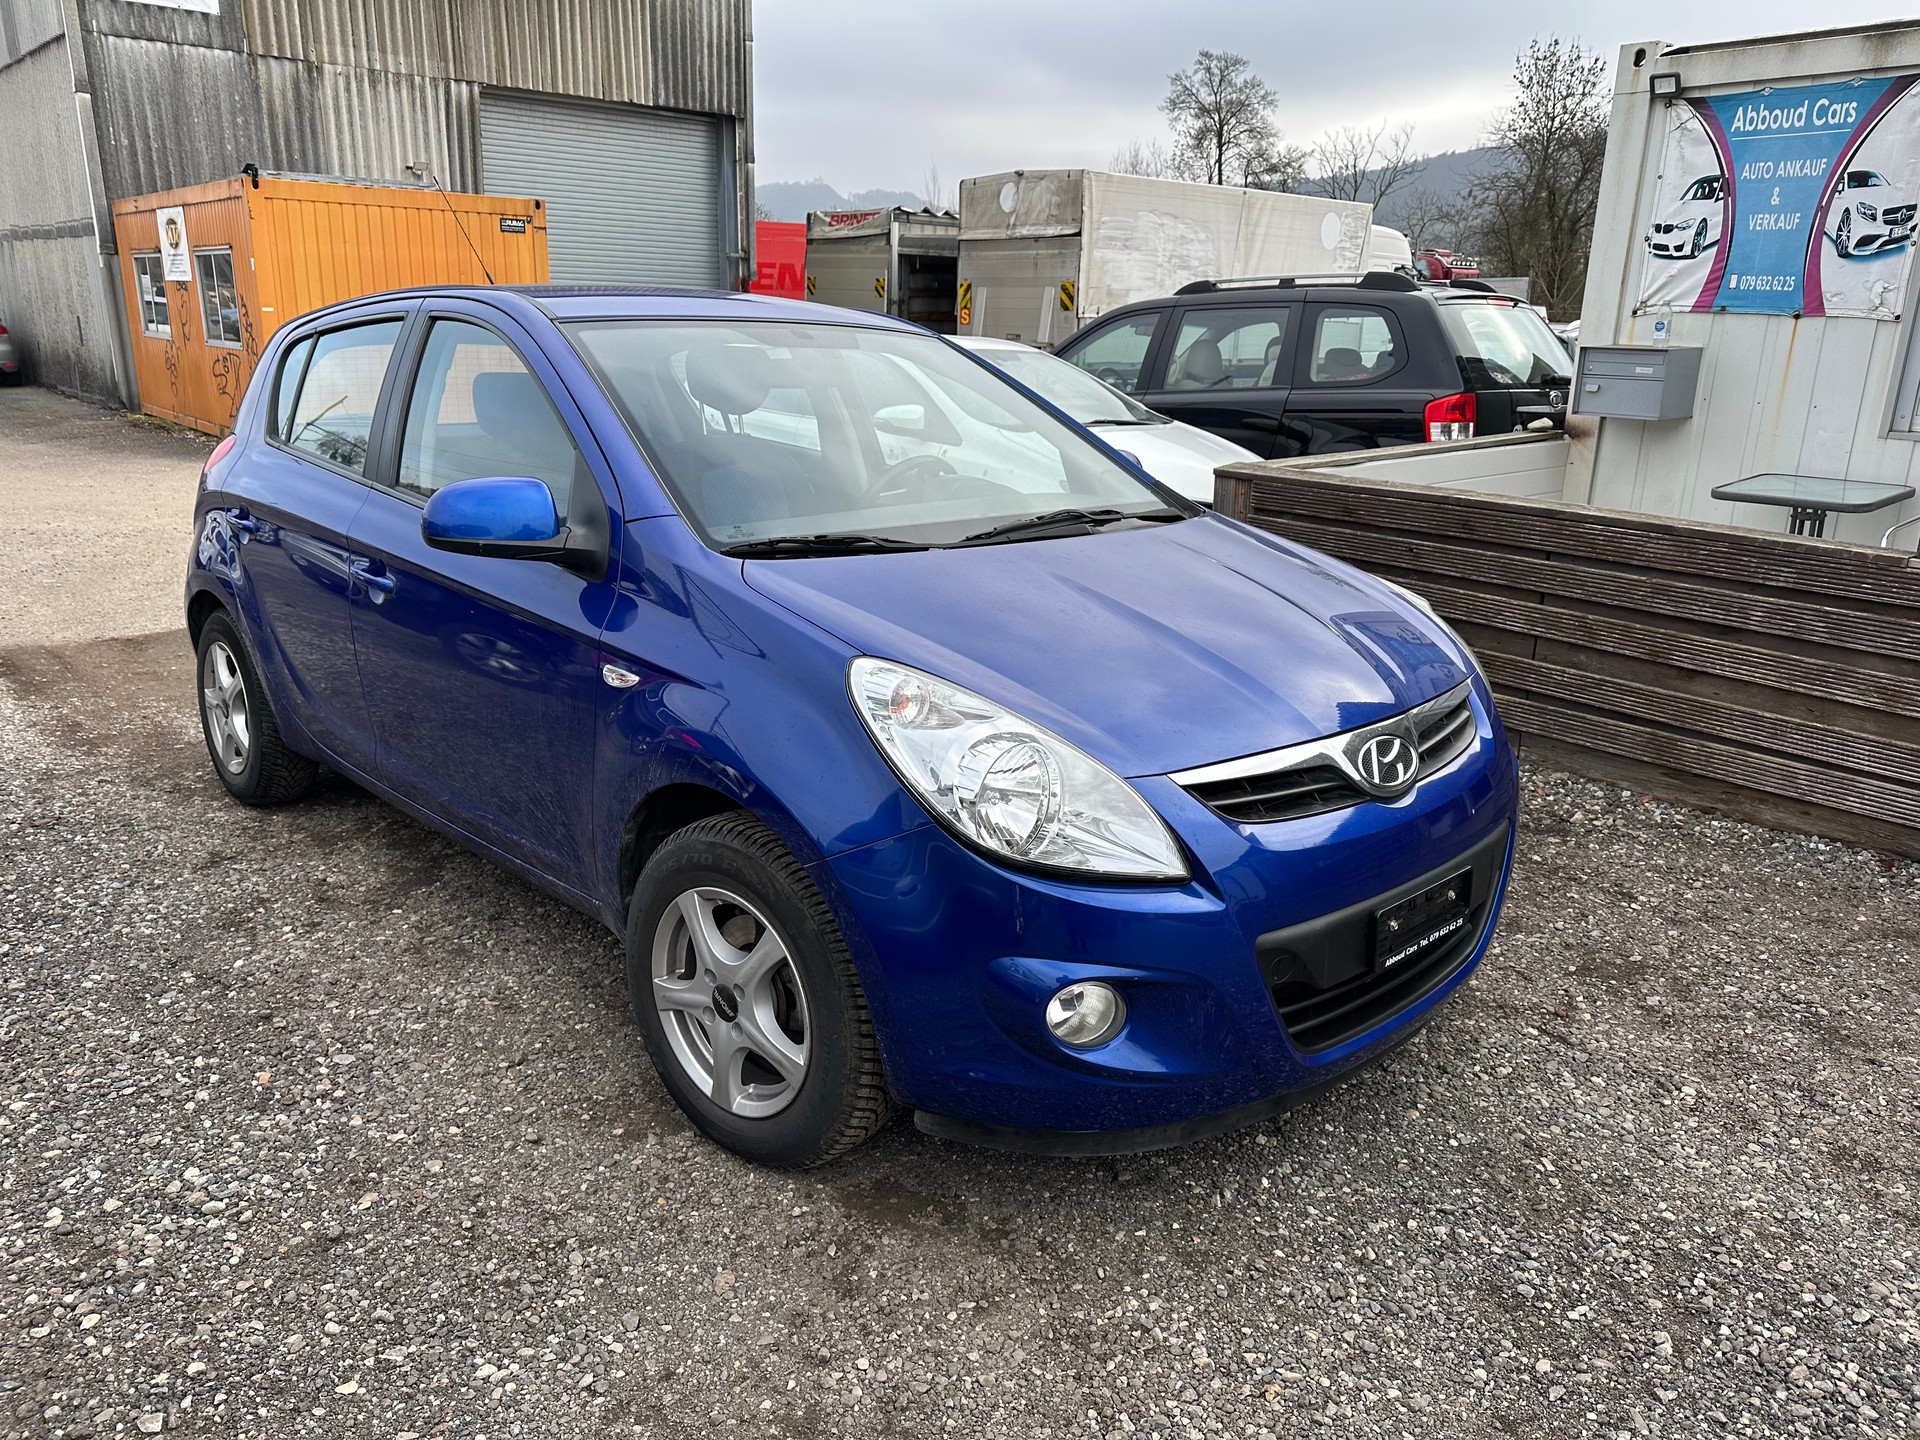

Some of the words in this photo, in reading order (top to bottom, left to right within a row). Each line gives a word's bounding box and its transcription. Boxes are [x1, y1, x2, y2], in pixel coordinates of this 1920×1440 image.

[1731, 100, 1808, 132] Abboud
[1812, 98, 1858, 125] Cars
[1741, 162, 1774, 180] AUTO
[1775, 158, 1827, 178] ANKAUF
[1770, 187, 1780, 205] &
[1749, 212, 1801, 231] VERKAUF
[1740, 275, 1756, 291] 079
[1756, 275, 1773, 291] 632
[961, 308, 970, 324] S
[1385, 950, 1406, 968] Abboud
[1406, 944, 1418, 956] Cars
[1419, 937, 1430, 948] Tel.
[1429, 931, 1440, 942] 079
[1439, 925, 1450, 937] 632
[1449, 921, 1457, 931] 62
[1456, 917, 1464, 927] 25
